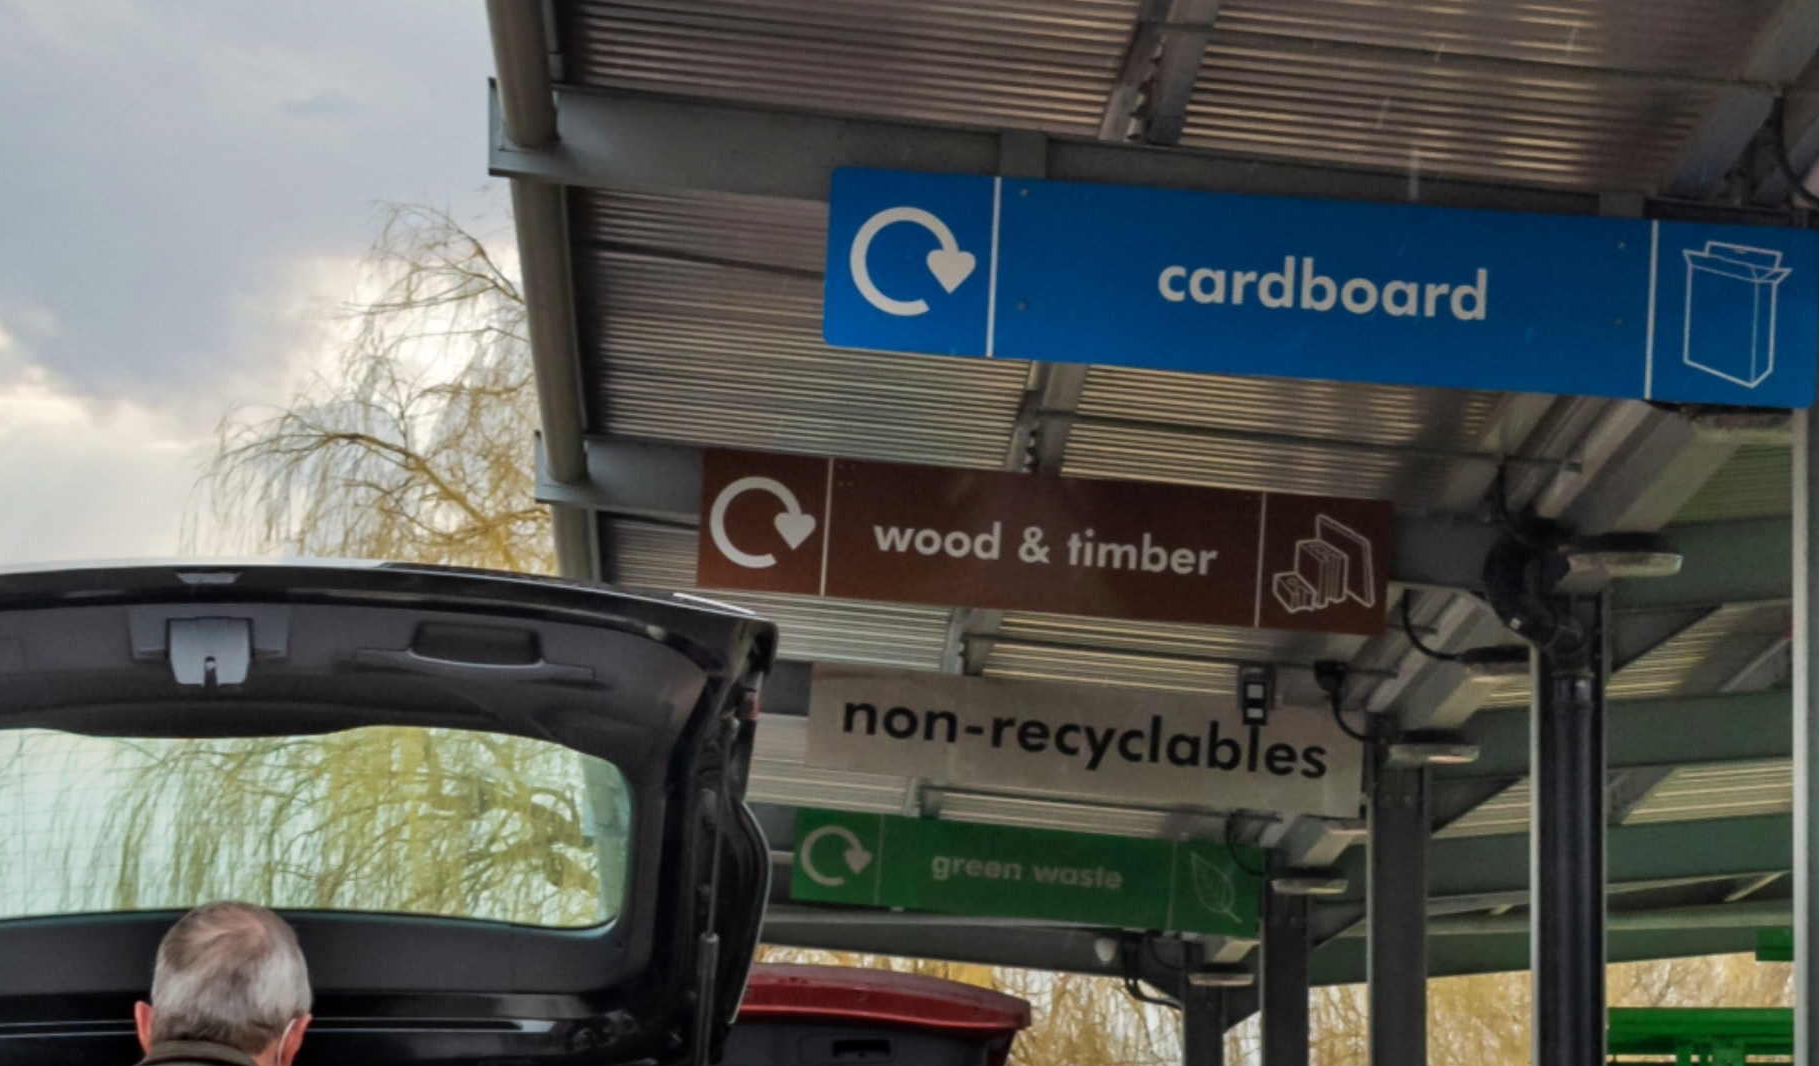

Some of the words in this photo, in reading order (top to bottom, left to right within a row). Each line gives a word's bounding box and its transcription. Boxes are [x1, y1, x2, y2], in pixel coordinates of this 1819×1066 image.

[1158, 256, 1487, 320] cardboard
[874, 522, 1001, 560] wood
[1018, 526, 1051, 565] &
[1067, 529, 1218, 576] timber
[843, 700, 1328, 780] non-recyclables
[932, 854, 1023, 882] green
[1033, 862, 1123, 889] waste
